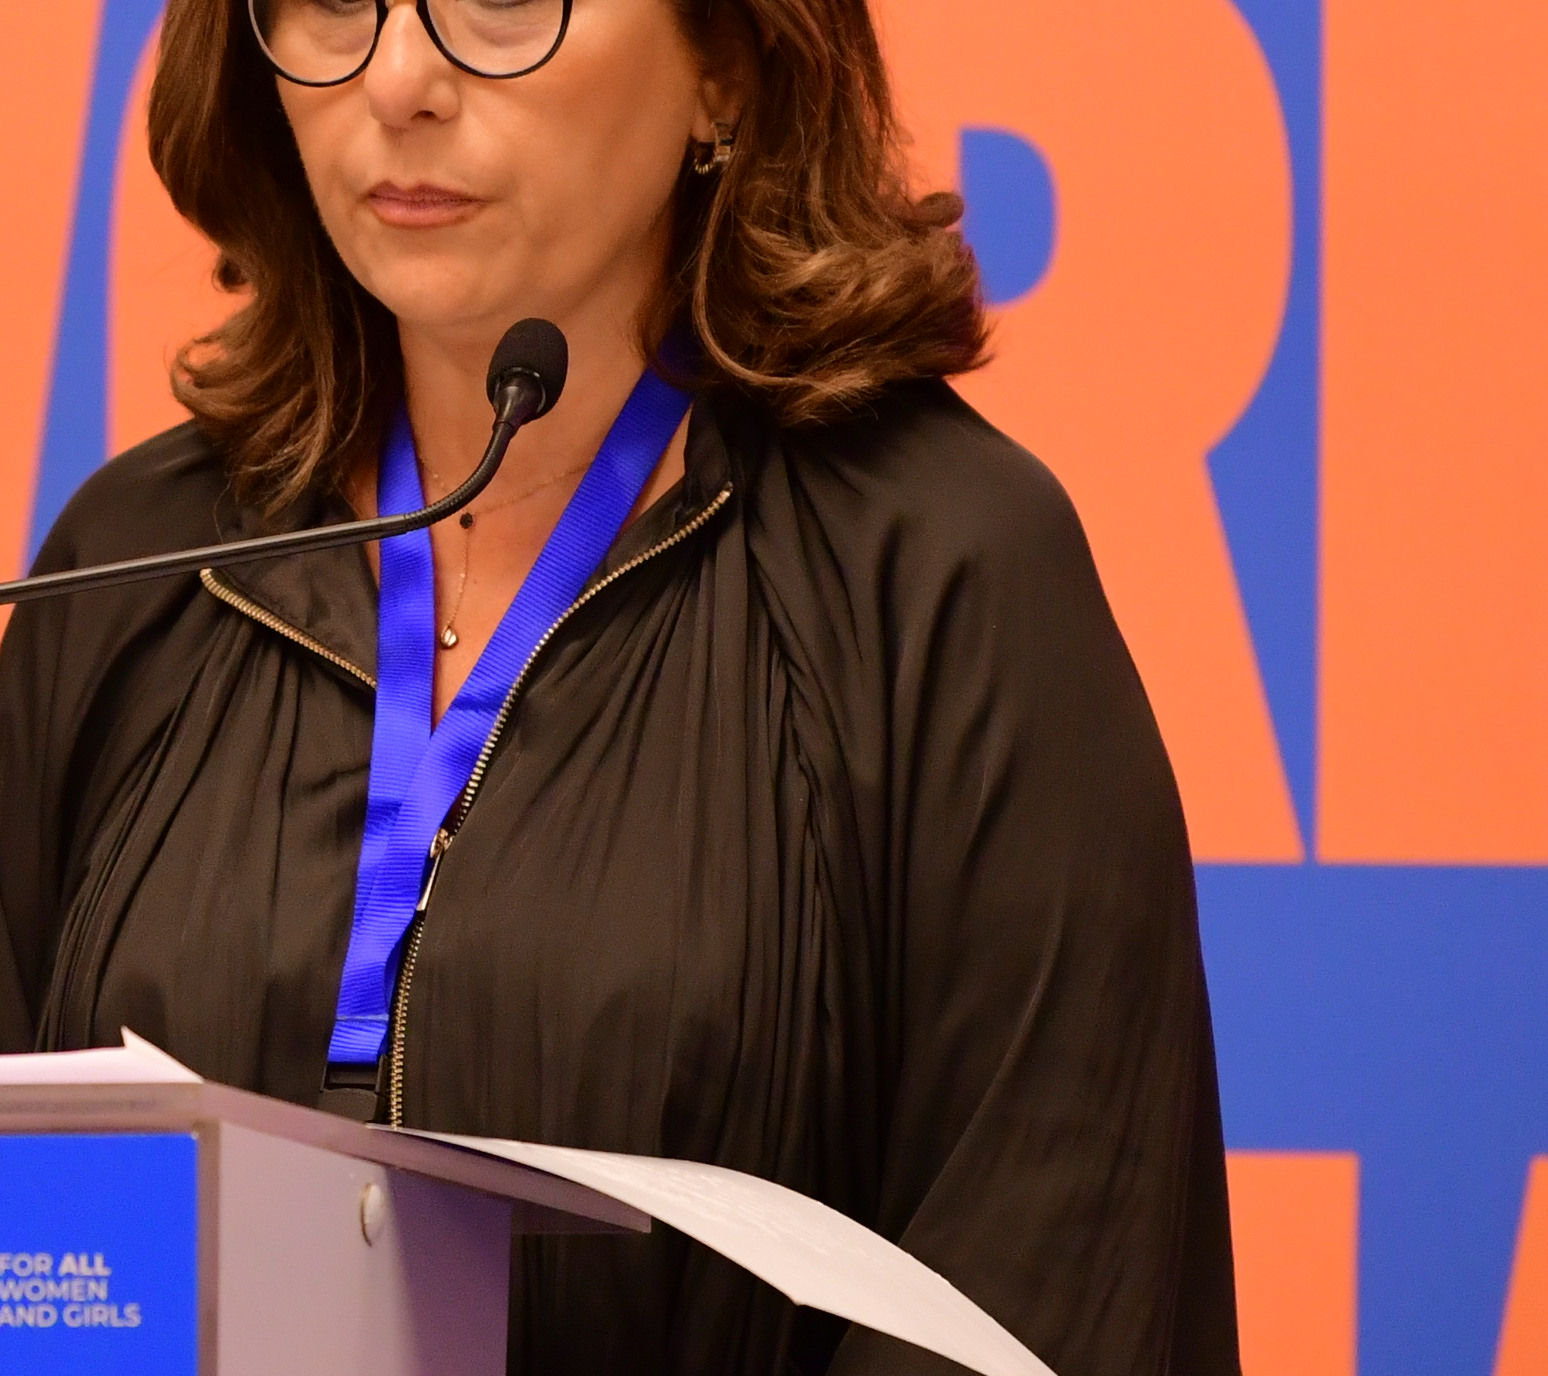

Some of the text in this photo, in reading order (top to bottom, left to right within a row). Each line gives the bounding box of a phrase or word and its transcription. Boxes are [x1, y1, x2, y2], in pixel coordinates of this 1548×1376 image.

[60, 1254, 109, 1276] ALL
[0, 1281, 106, 1300] WOMEN
[64, 1304, 140, 1326] GIRLS
